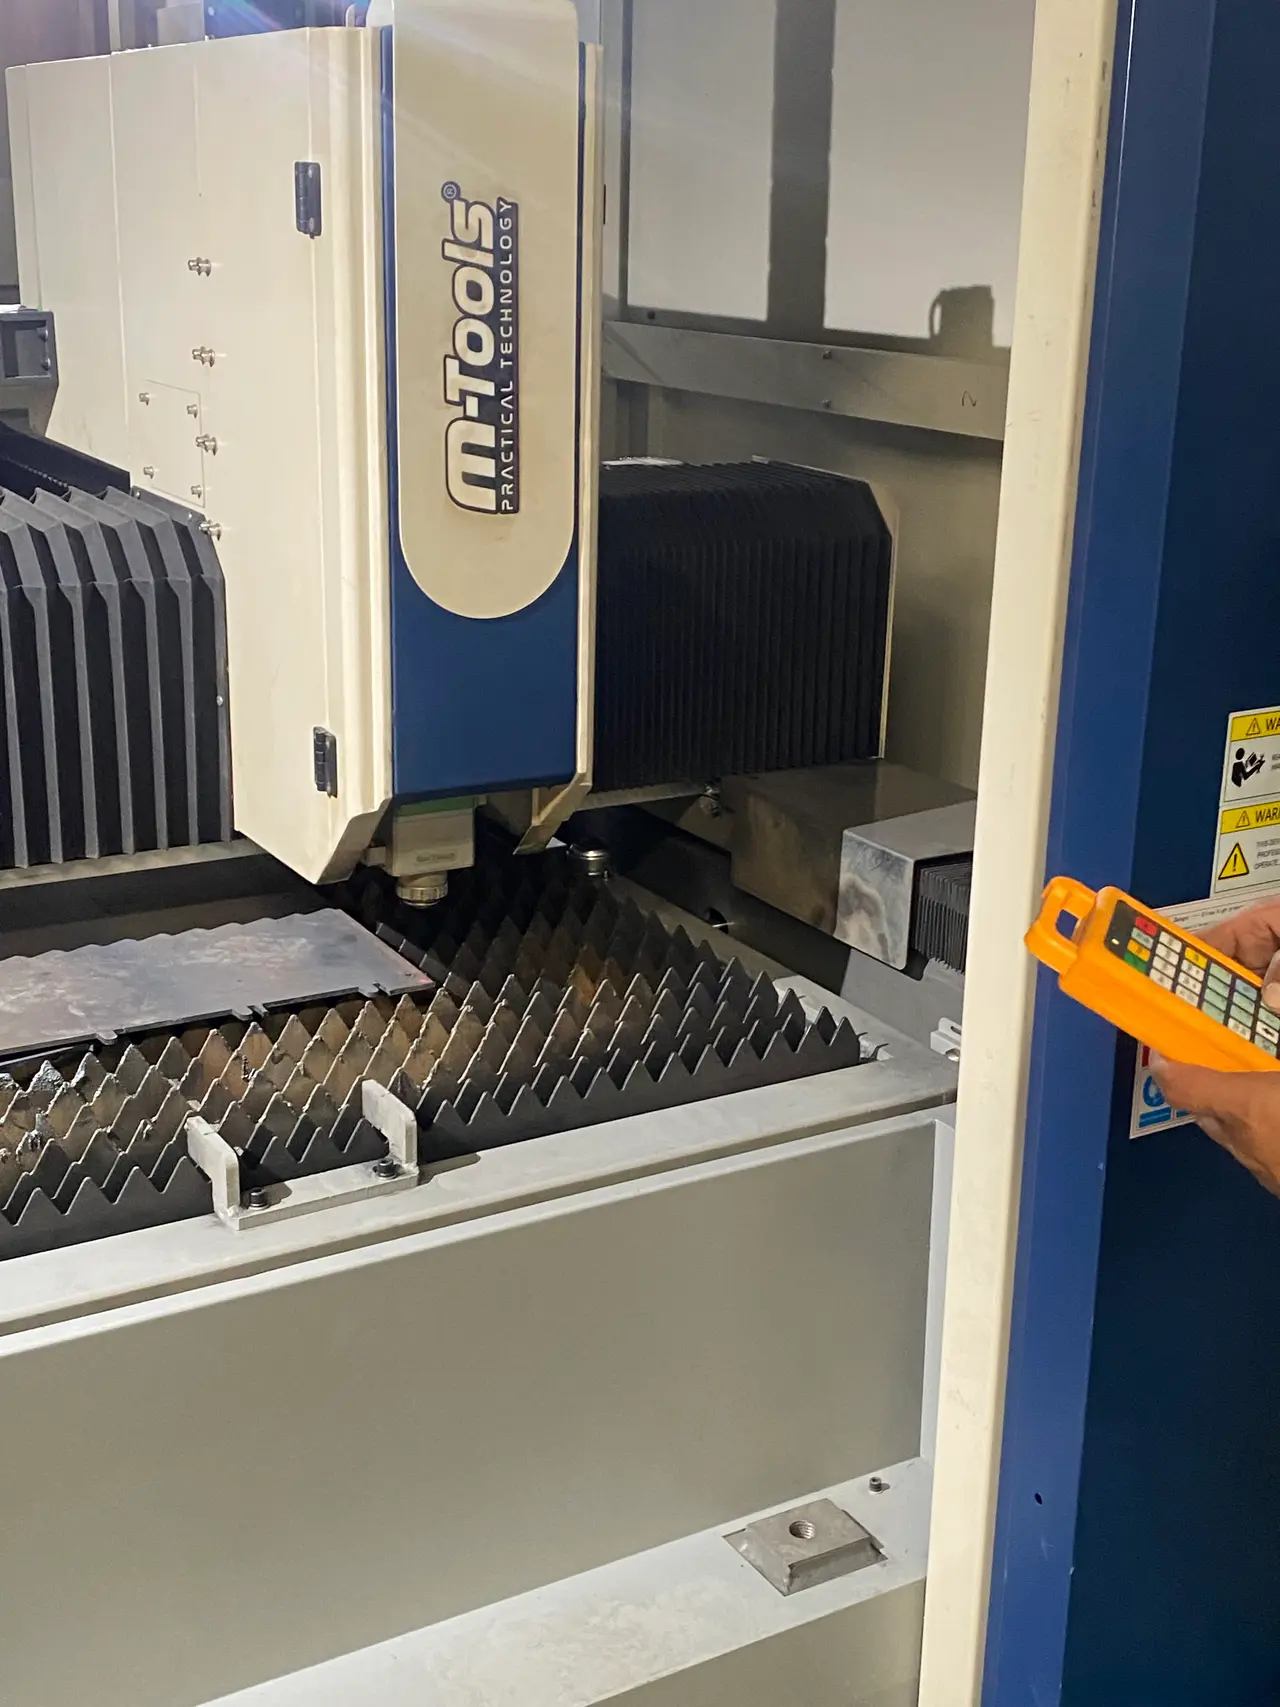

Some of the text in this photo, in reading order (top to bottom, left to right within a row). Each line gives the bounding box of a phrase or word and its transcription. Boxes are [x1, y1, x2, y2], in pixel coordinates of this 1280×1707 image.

[500, 200, 514, 511] PRACTICAL TECHNOLOGY
[1255, 807, 1280, 823] WAR
